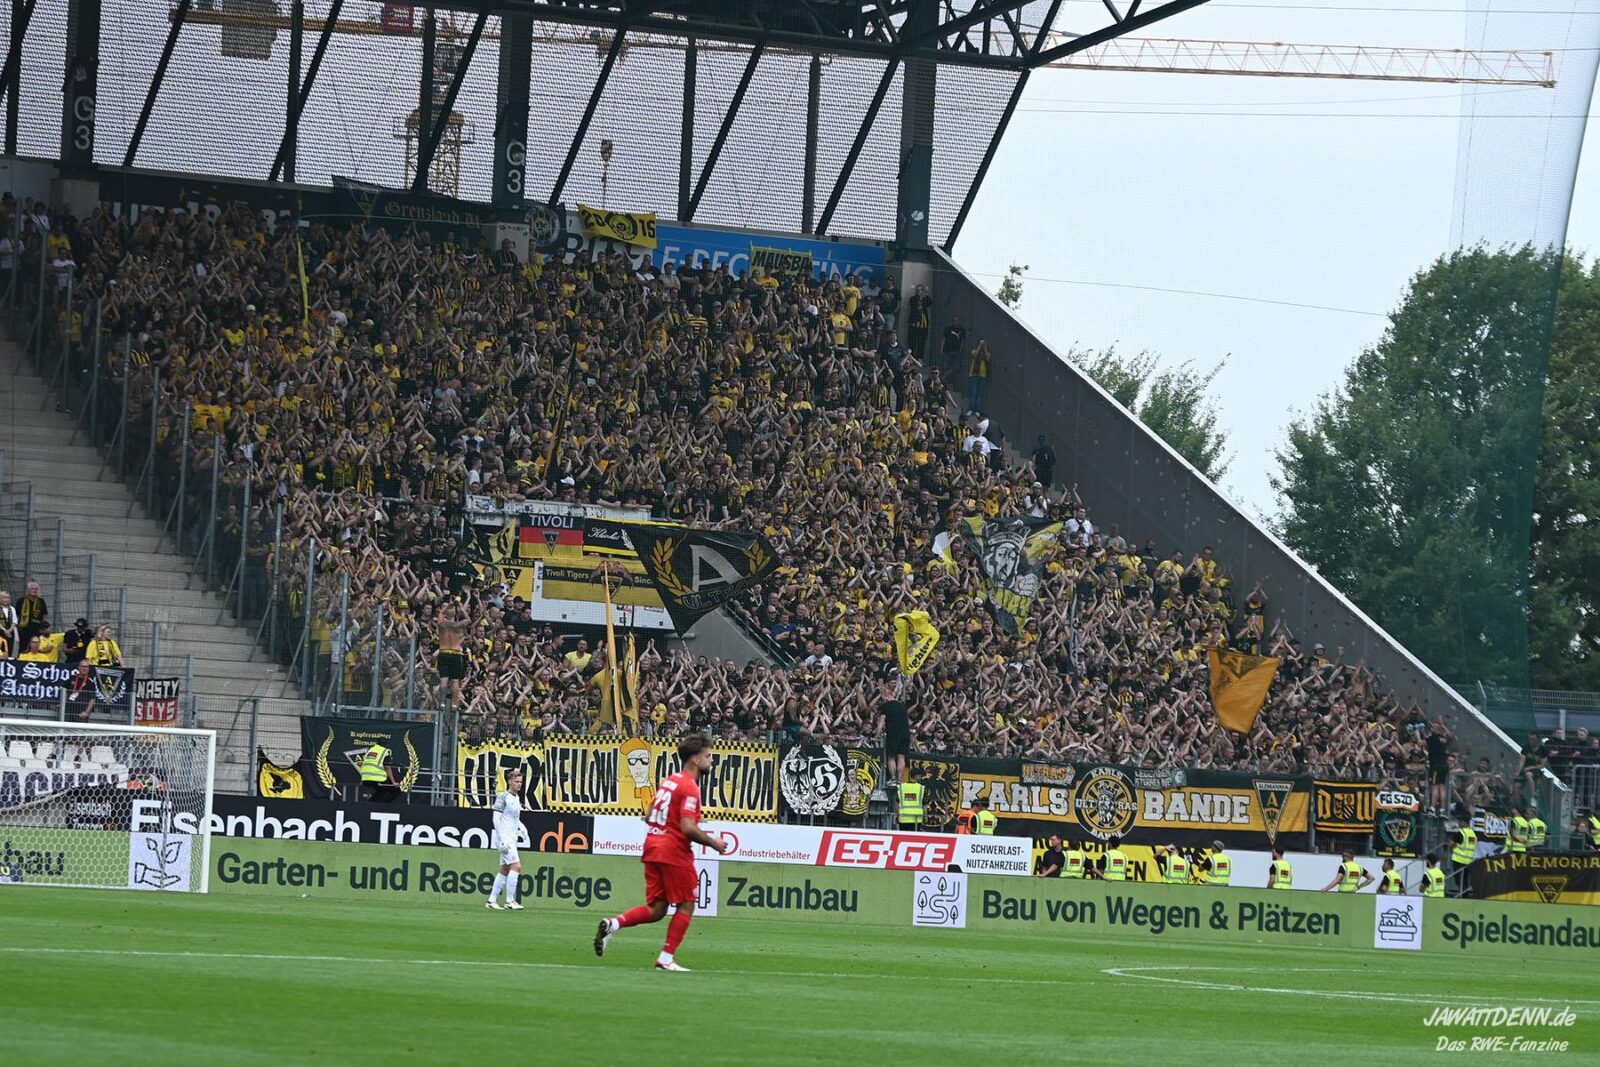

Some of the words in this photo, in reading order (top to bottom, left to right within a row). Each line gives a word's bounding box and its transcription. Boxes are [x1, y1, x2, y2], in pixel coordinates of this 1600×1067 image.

[752, 250, 813, 274] MAUSBA
[530, 514, 574, 529] TIVOLI
[545, 567, 566, 577] Tivoli
[568, 569, 589, 581] Tigers
[634, 575, 653, 585] Sinc
[136, 680, 179, 699] NASTY
[547, 746, 618, 803] YELLOW
[961, 779, 1069, 817] KARLS
[1144, 790, 1251, 823] BANDE
[1266, 791, 1279, 807] A
[130, 799, 362, 843] Eisenbach
[594, 841, 643, 852] Pufferspeic
[739, 848, 811, 861] Industriebehälter
[970, 844, 1025, 857] SCHWERLAST-
[966, 858, 1028, 872] NUTZFAHRZEUGE
[1484, 858, 1506, 873] IN
[219, 853, 339, 887] Garten-
[350, 860, 408, 891] und
[419, 862, 612, 908] Rasepflege
[727, 877, 858, 912] Zaunbau
[982, 889, 1037, 922] Bau
[1049, 899, 1096, 923] von
[1105, 896, 1200, 935] Wegen
[1208, 902, 1233, 931] &
[1238, 902, 1340, 936] Plätzen
